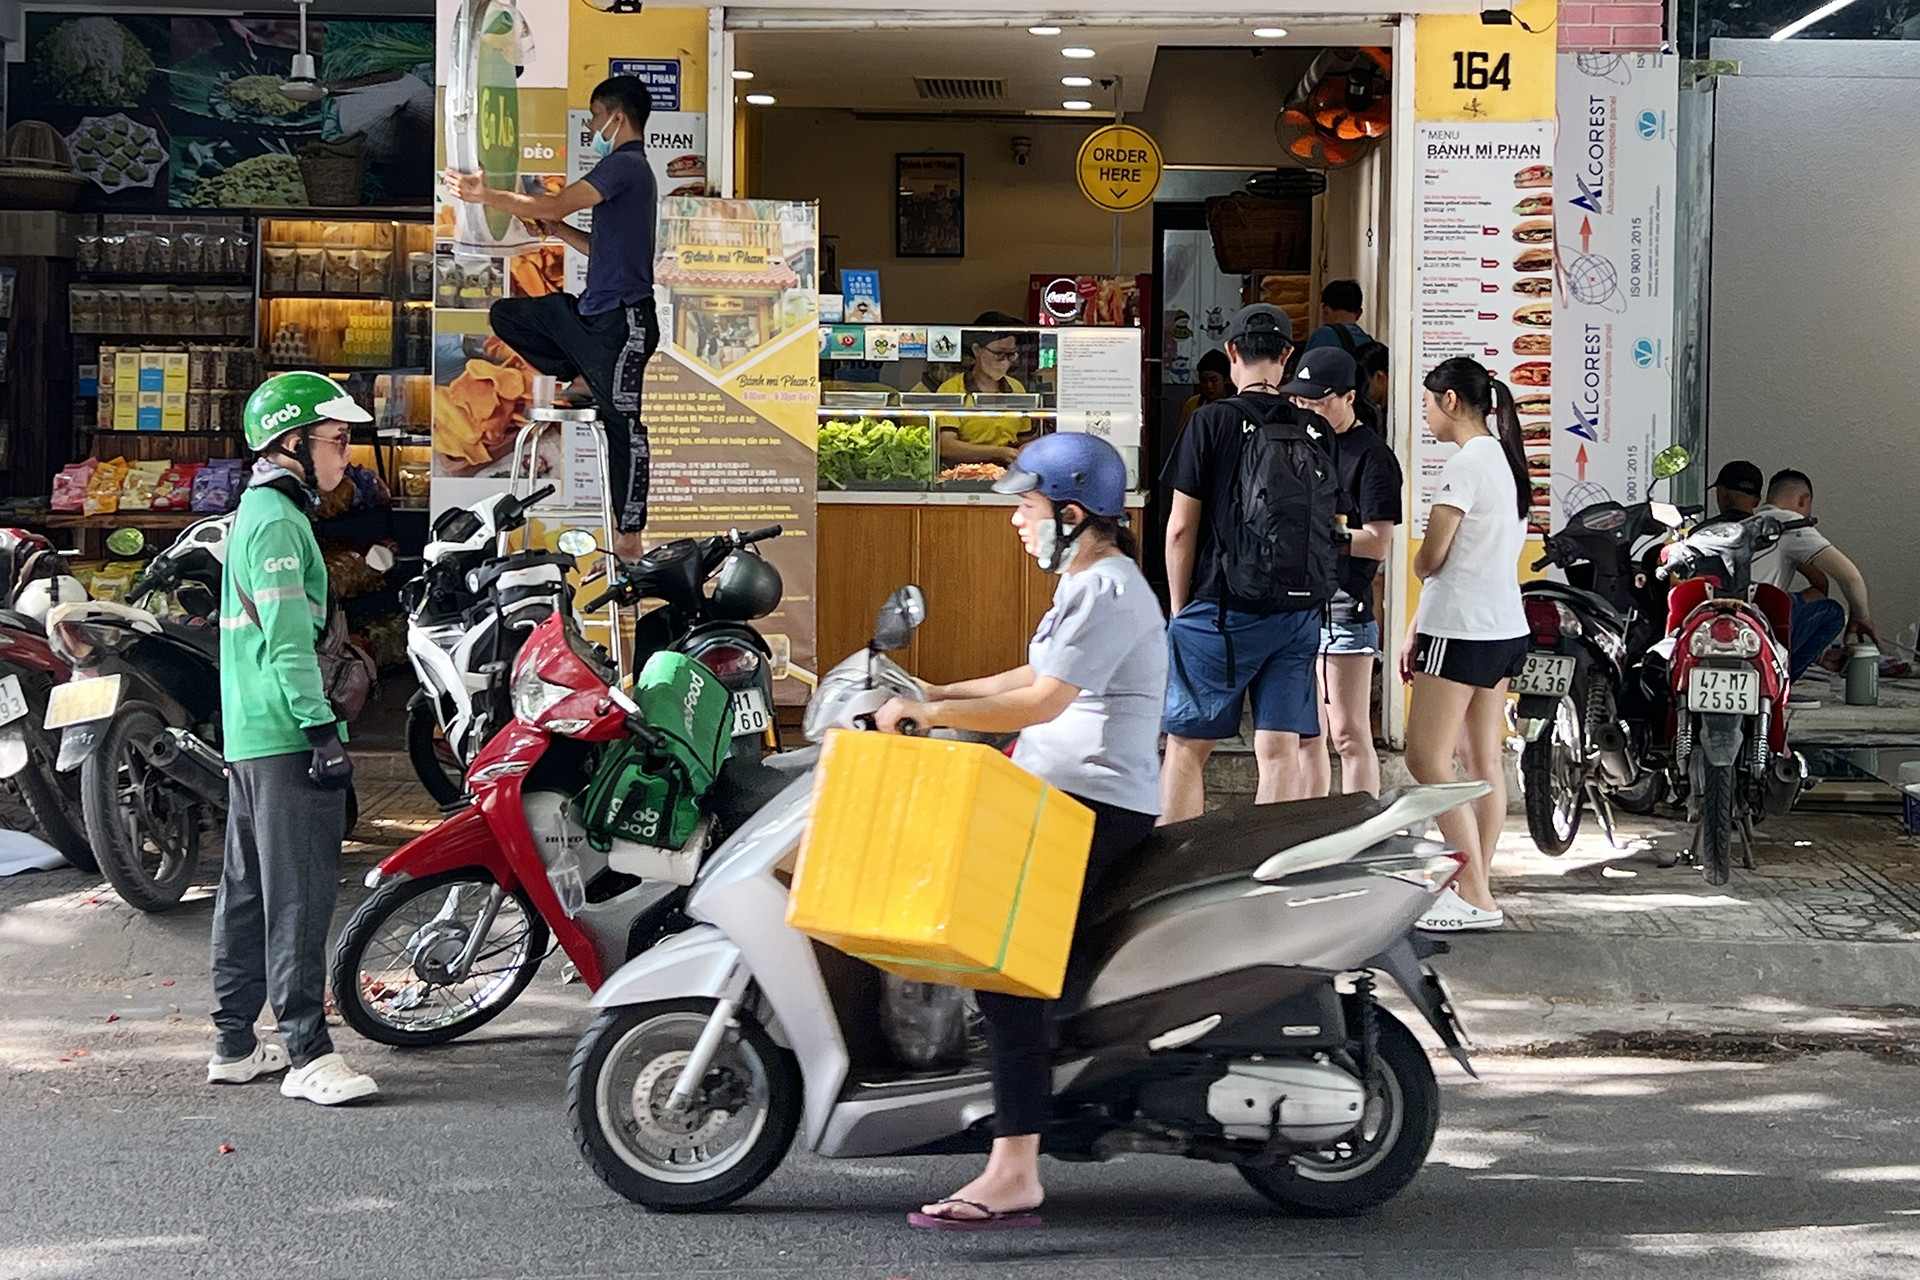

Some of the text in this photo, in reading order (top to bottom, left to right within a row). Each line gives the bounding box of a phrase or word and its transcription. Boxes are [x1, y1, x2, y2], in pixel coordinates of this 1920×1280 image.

[1453, 51, 1511, 91] 164
[650, 133, 693, 146] PHAN
[1428, 130, 1460, 140] MENU
[1092, 147, 1148, 163] ORDER
[1427, 141, 1541, 156] BÁNH MÌ PHAN
[1568, 94, 1606, 216] ALCOREST
[1605, 94, 1619, 215] Aluminum composite panel
[1099, 168, 1141, 182] HERE
[732, 250, 764, 264] Phan
[1630, 276, 1641, 298] ISO
[780, 374, 808, 388] Phan
[809, 376, 817, 387] 2
[1564, 322, 1601, 444] ALCOREST
[1602, 323, 1614, 444] Aluminum composite panel
[260, 403, 302, 431] Grab
[1700, 671, 1748, 688] 47-M7
[1699, 691, 1748, 711] 2555
[1426, 919, 1464, 928] crocs
